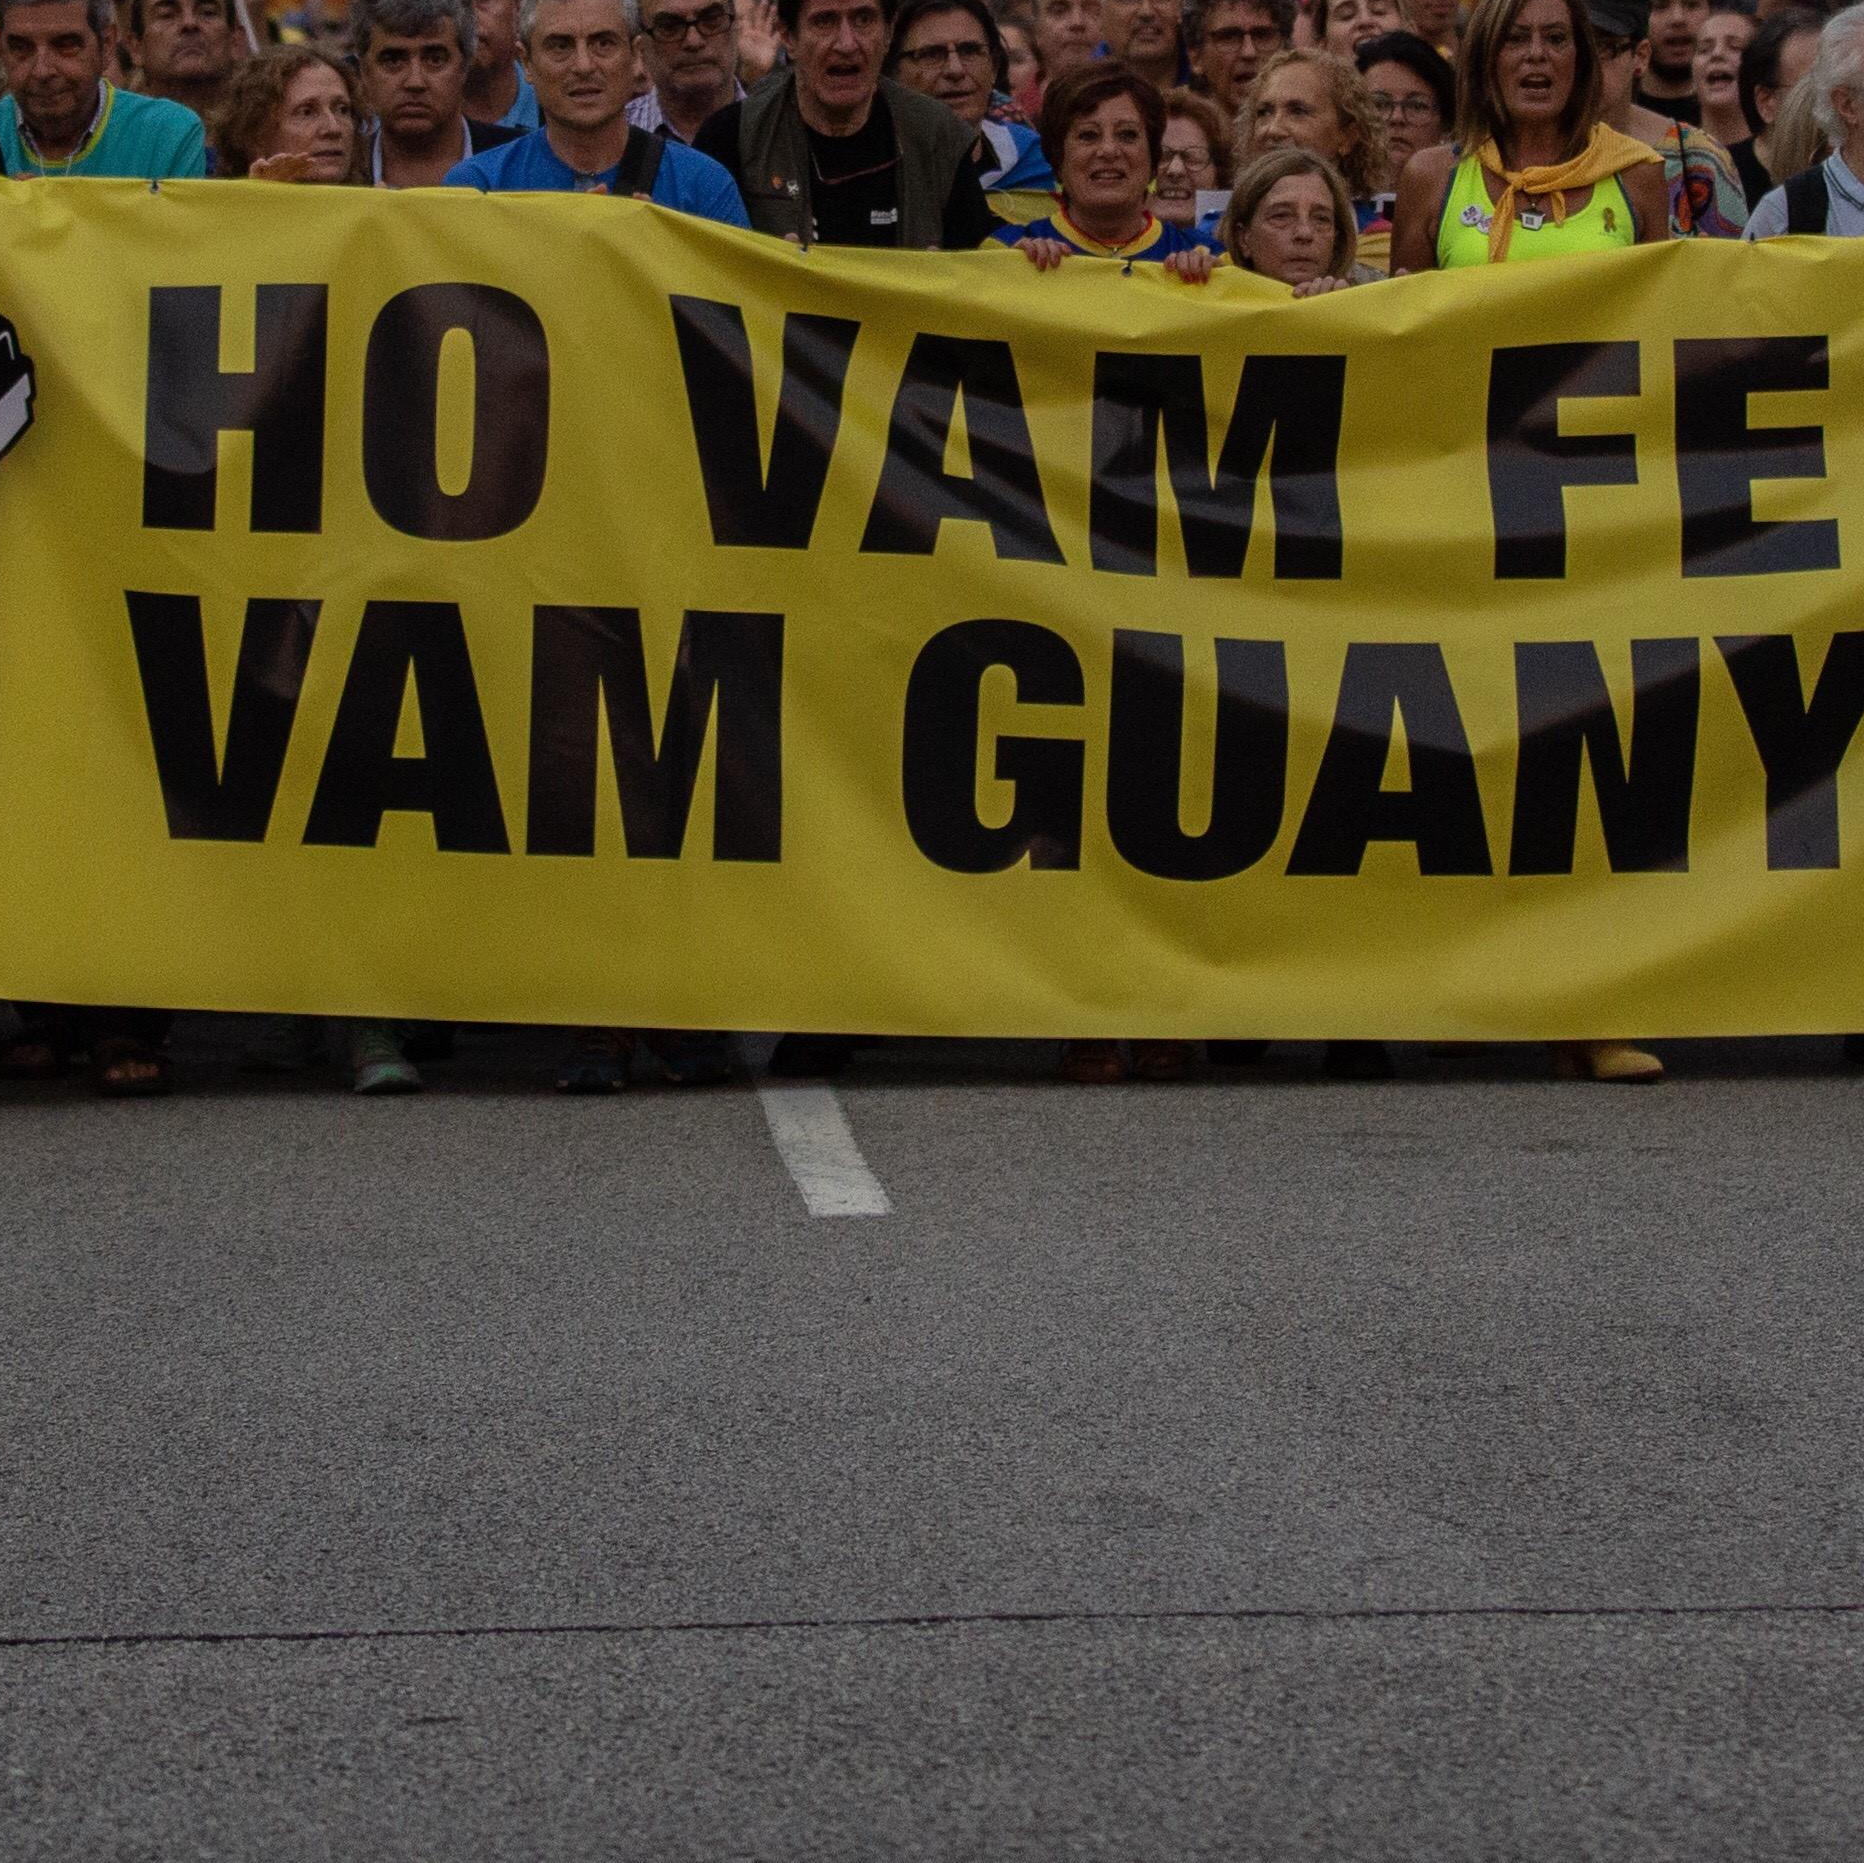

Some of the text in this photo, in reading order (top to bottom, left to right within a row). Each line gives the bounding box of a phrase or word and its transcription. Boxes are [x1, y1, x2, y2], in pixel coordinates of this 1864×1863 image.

[144, 283, 549, 541] HO
[670, 295, 1345, 580] VAM
[125, 590, 784, 863] VAM
